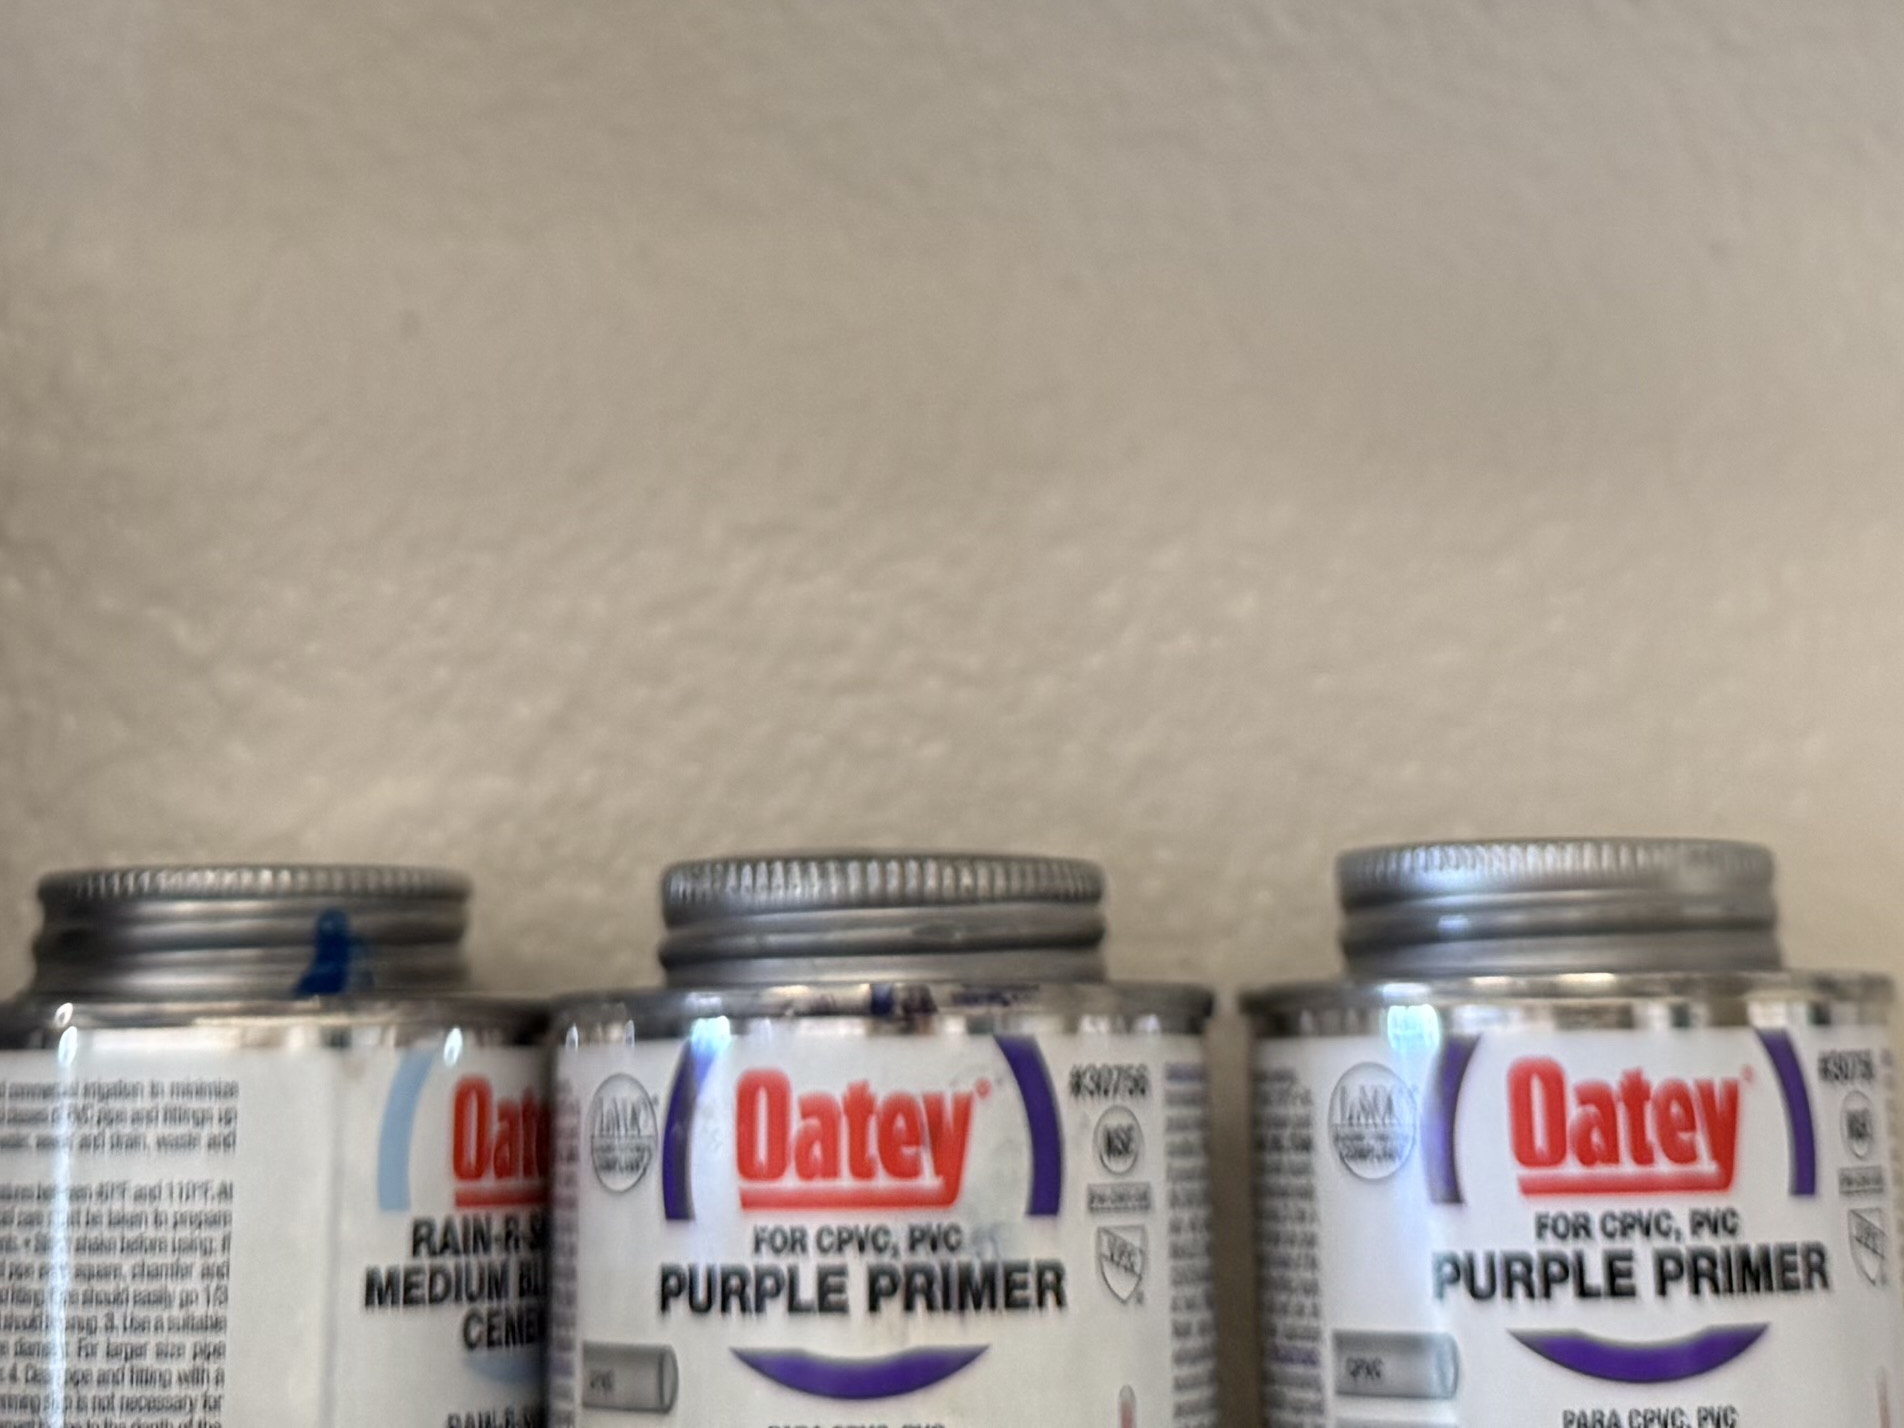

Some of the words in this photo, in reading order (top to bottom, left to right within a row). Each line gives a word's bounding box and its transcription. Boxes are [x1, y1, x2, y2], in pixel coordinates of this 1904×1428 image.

[453, 1074, 548, 1208] Oat
[735, 1069, 974, 1212] Oatey
[1506, 1054, 1741, 1197] Oatey
[753, 1224, 807, 1257] FOR
[816, 1224, 898, 1259] CPVC,
[908, 1223, 962, 1253] PVC
[1536, 1211, 1591, 1241] FOR
[1600, 1209, 1682, 1242] CPVC,
[1690, 1208, 1739, 1238] PVC
[364, 1263, 510, 1308] MEDIUM
[660, 1260, 849, 1317] PURPLE
[867, 1259, 1068, 1314] PRIMER
[1433, 1249, 1637, 1301] PURPLE
[1653, 1248, 1830, 1297] PRIMER
